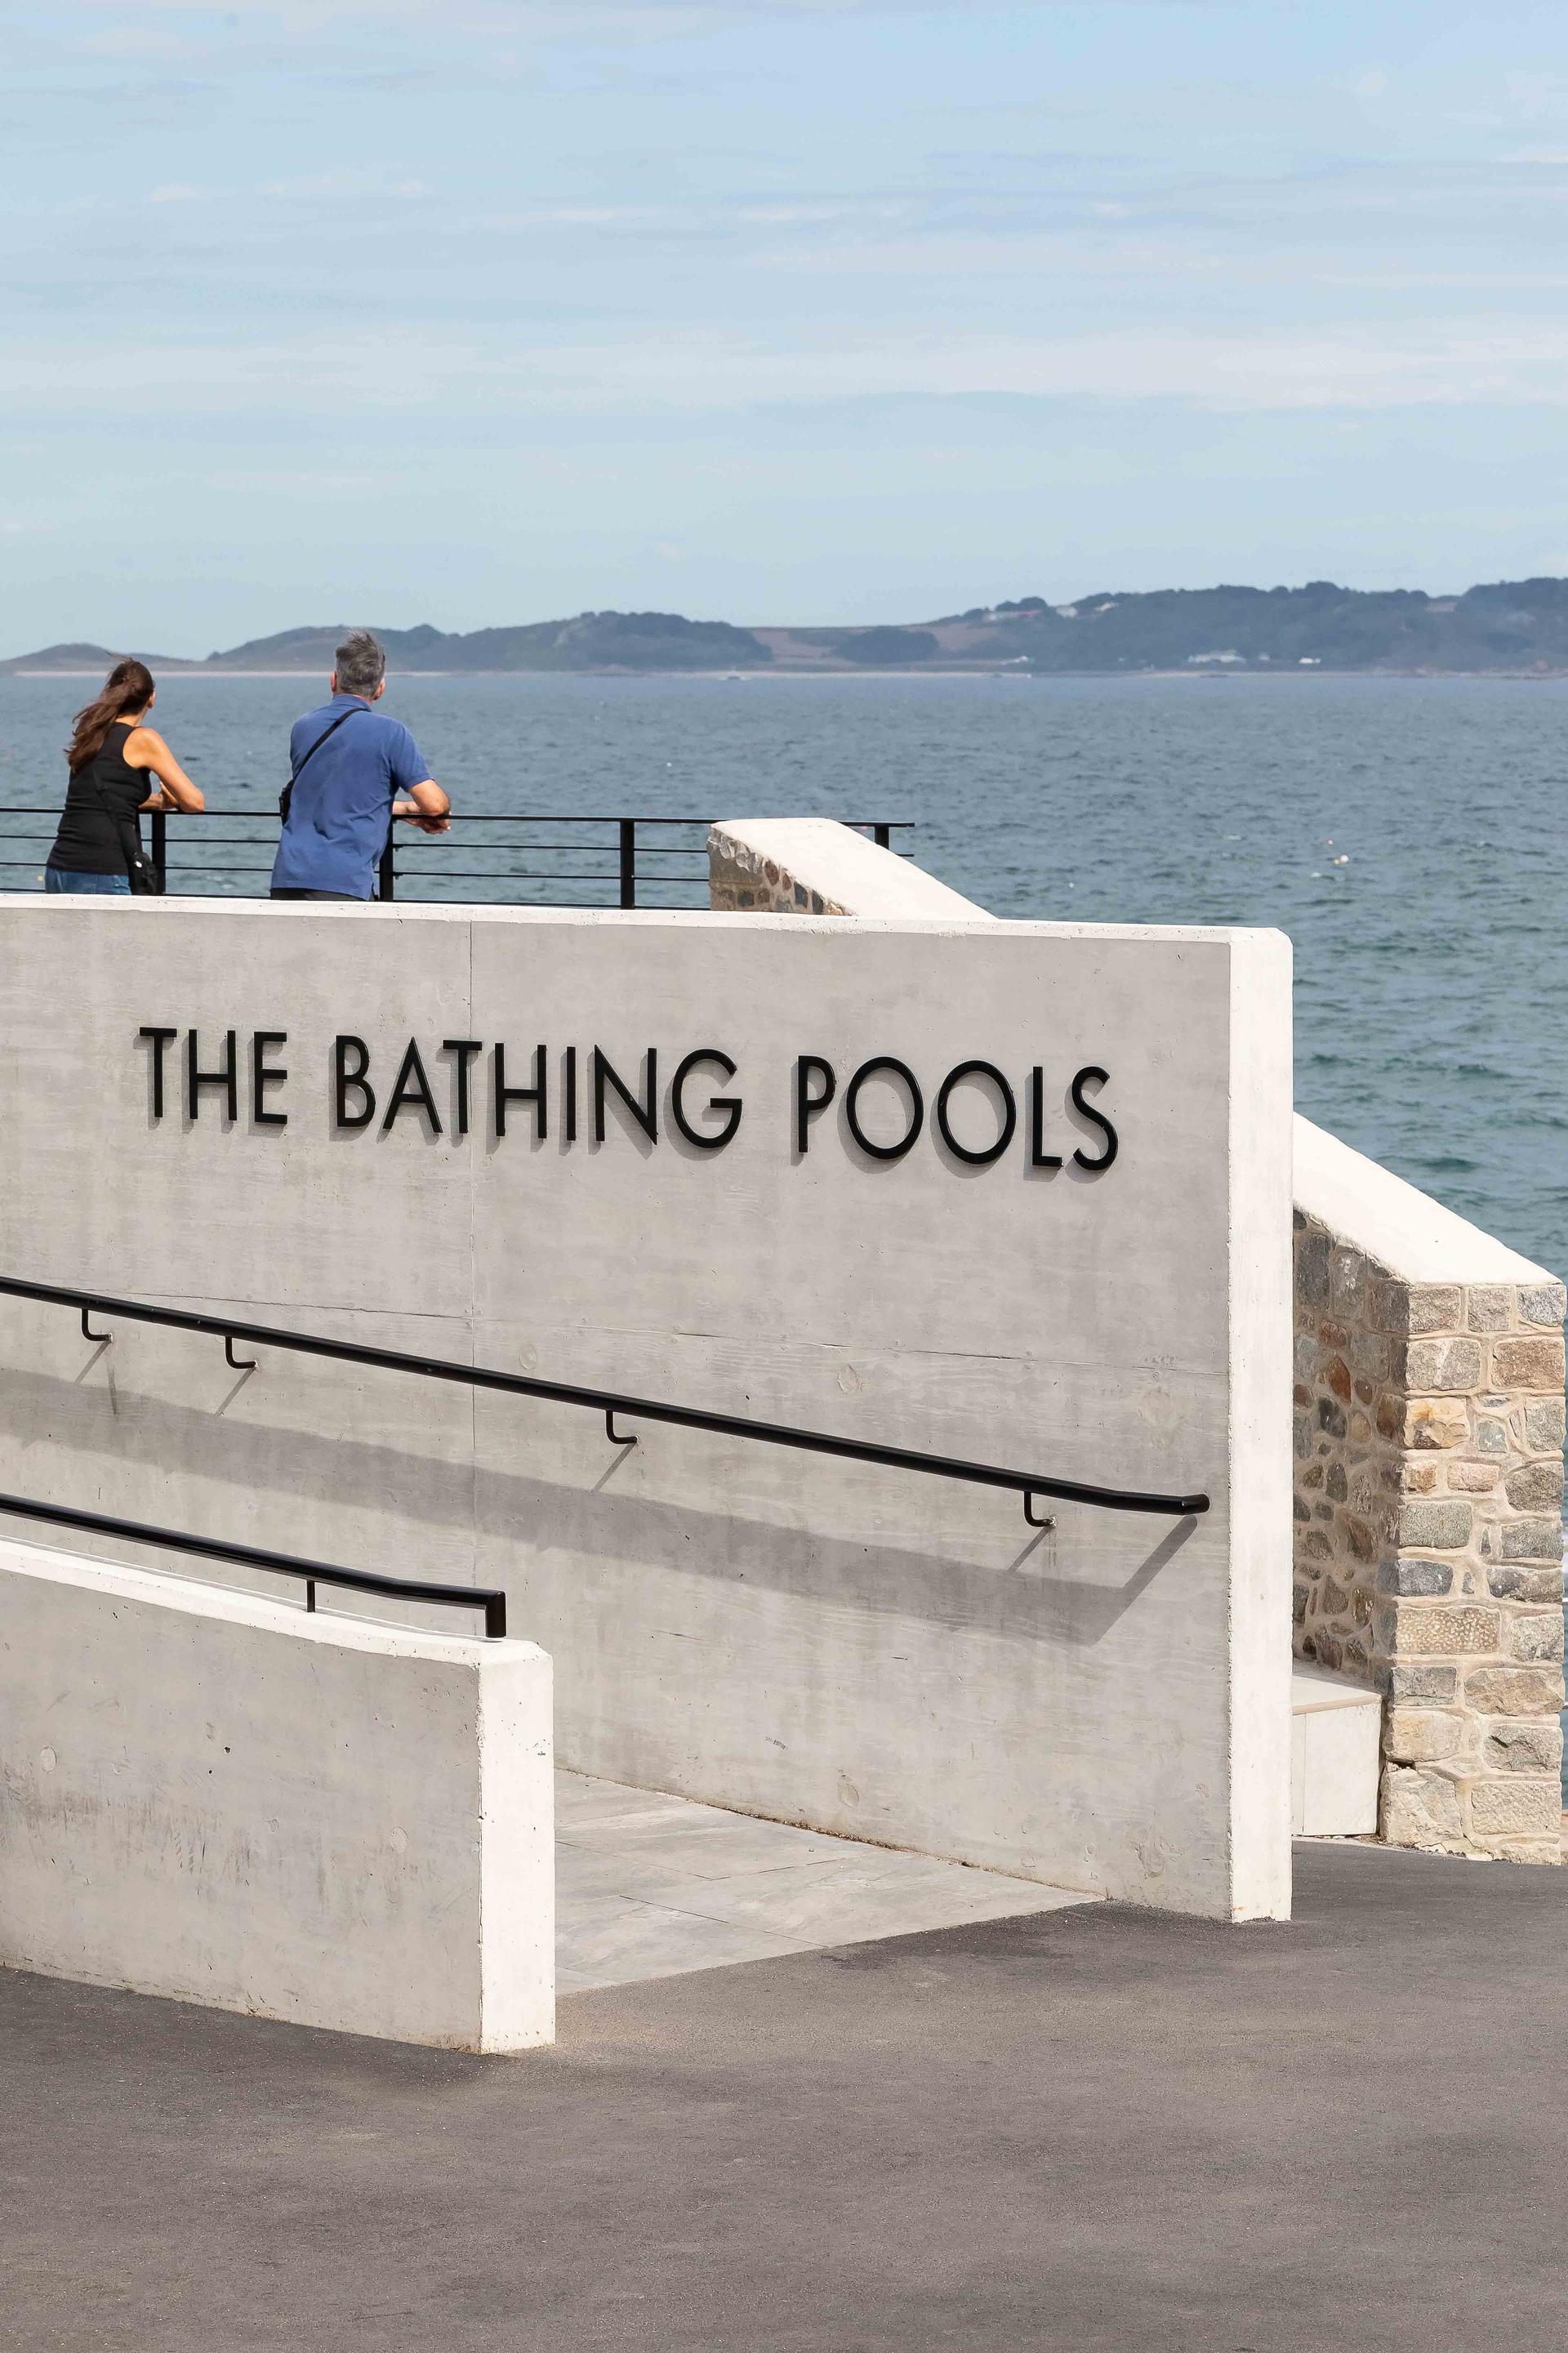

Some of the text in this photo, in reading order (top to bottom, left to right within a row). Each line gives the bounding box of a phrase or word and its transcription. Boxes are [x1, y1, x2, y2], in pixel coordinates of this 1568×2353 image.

[140, 1027, 1120, 1172] THE BATHING POOLS
